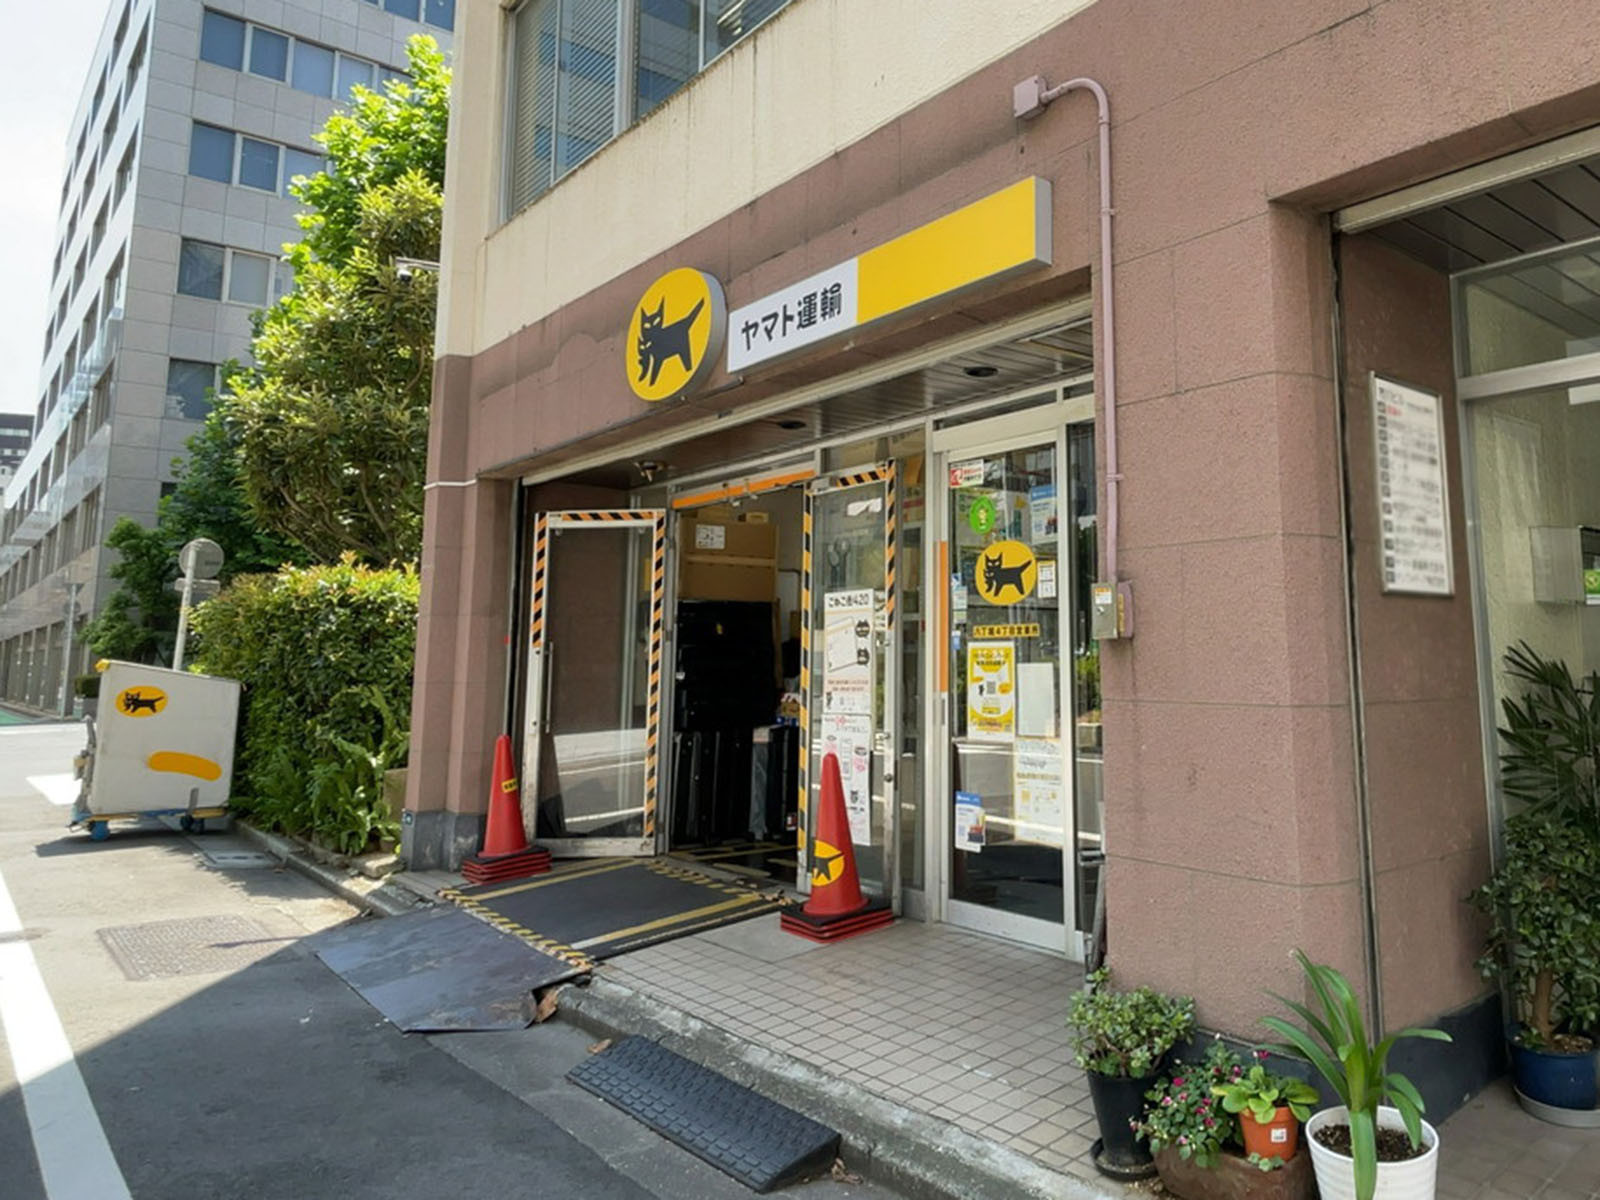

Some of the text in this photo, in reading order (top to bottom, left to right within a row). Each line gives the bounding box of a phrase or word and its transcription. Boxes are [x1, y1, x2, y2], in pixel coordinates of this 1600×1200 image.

[741, 282, 842, 351] ヤマト運輸
